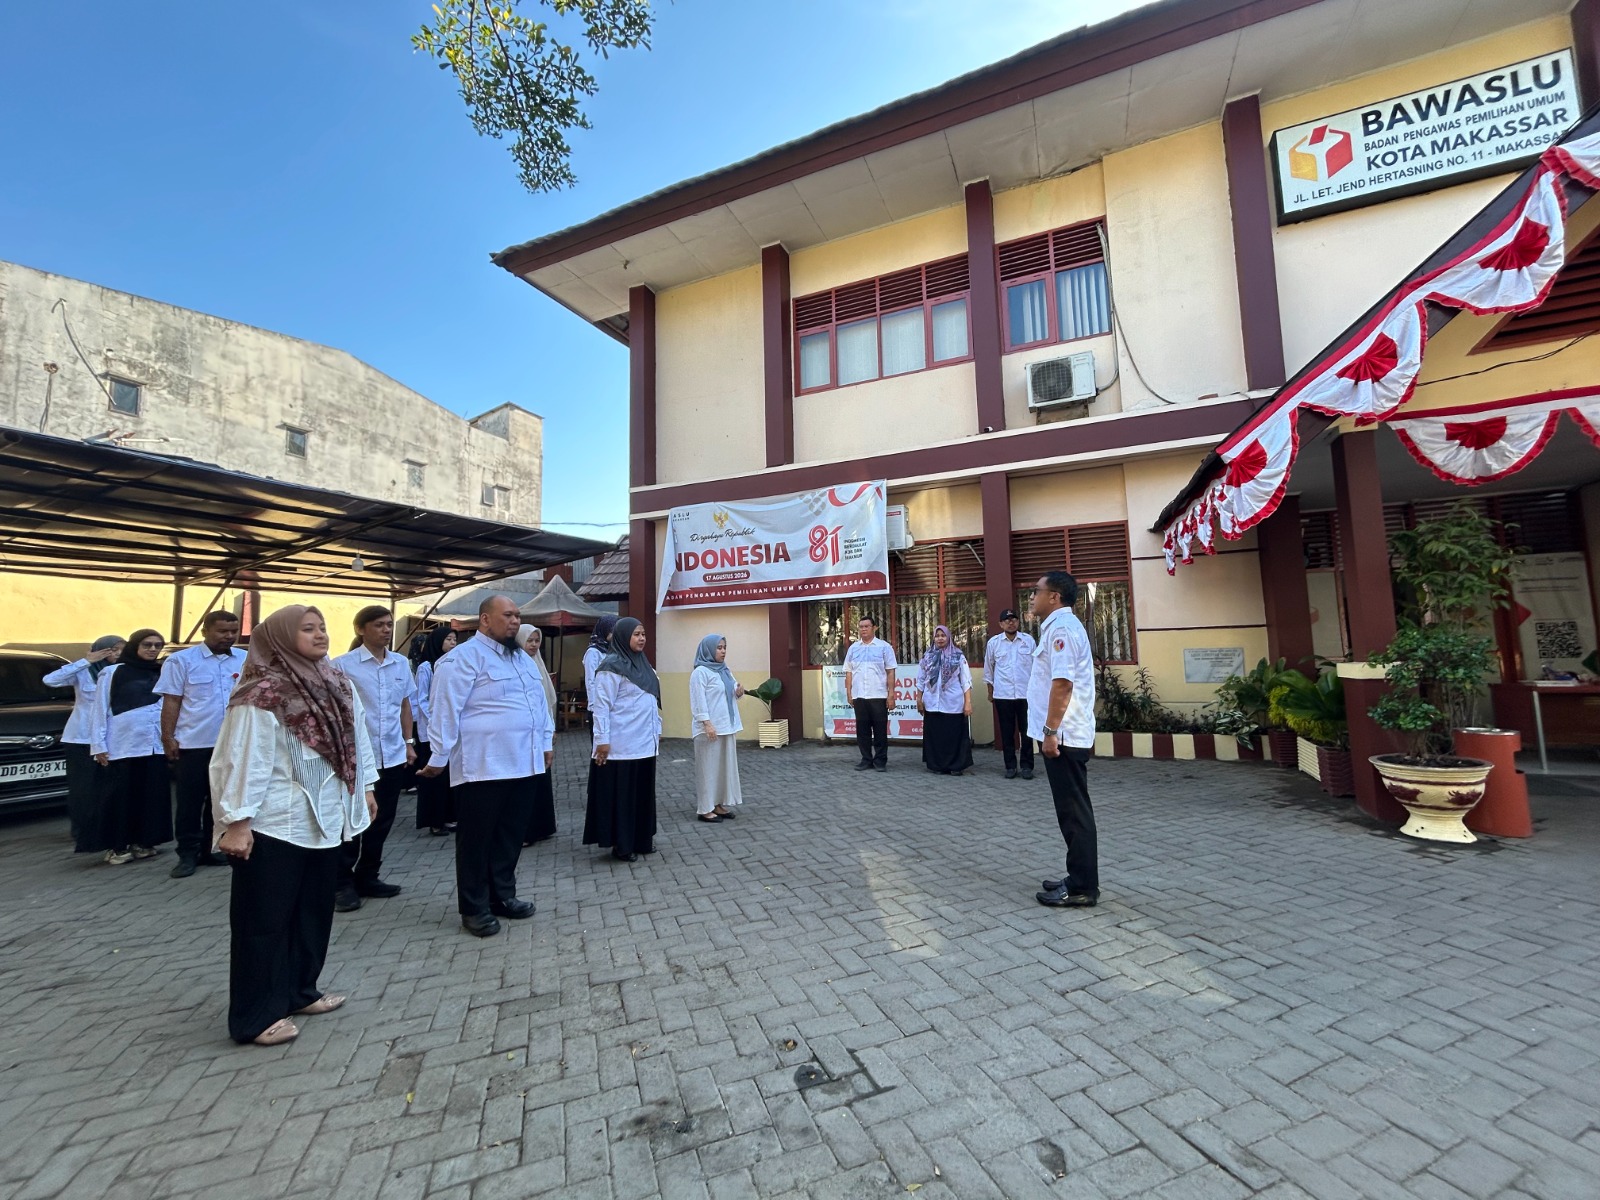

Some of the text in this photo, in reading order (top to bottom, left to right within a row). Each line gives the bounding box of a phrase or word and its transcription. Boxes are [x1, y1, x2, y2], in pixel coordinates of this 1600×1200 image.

[1361, 59, 1562, 137] BAWASLU
[1364, 91, 1566, 152] BADAN PENGAWAS PEMILIHAN UMUM
[1366, 107, 1569, 171] KOTA MAKASSAR
[1293, 194, 1309, 204] JL.
[1312, 186, 1334, 199] LET.
[1336, 178, 1366, 194] JEND
[1369, 160, 1444, 186] HERTASNING
[1446, 154, 1468, 168] NO.
[1471, 149, 1484, 162] 11
[808, 525, 843, 567] 81
[685, 591, 725, 599] PENGAWAS
[824, 578, 870, 588] MAKASSAR
[1, 767, 18, 776] DD
[20, 763, 51, 774] 1628
